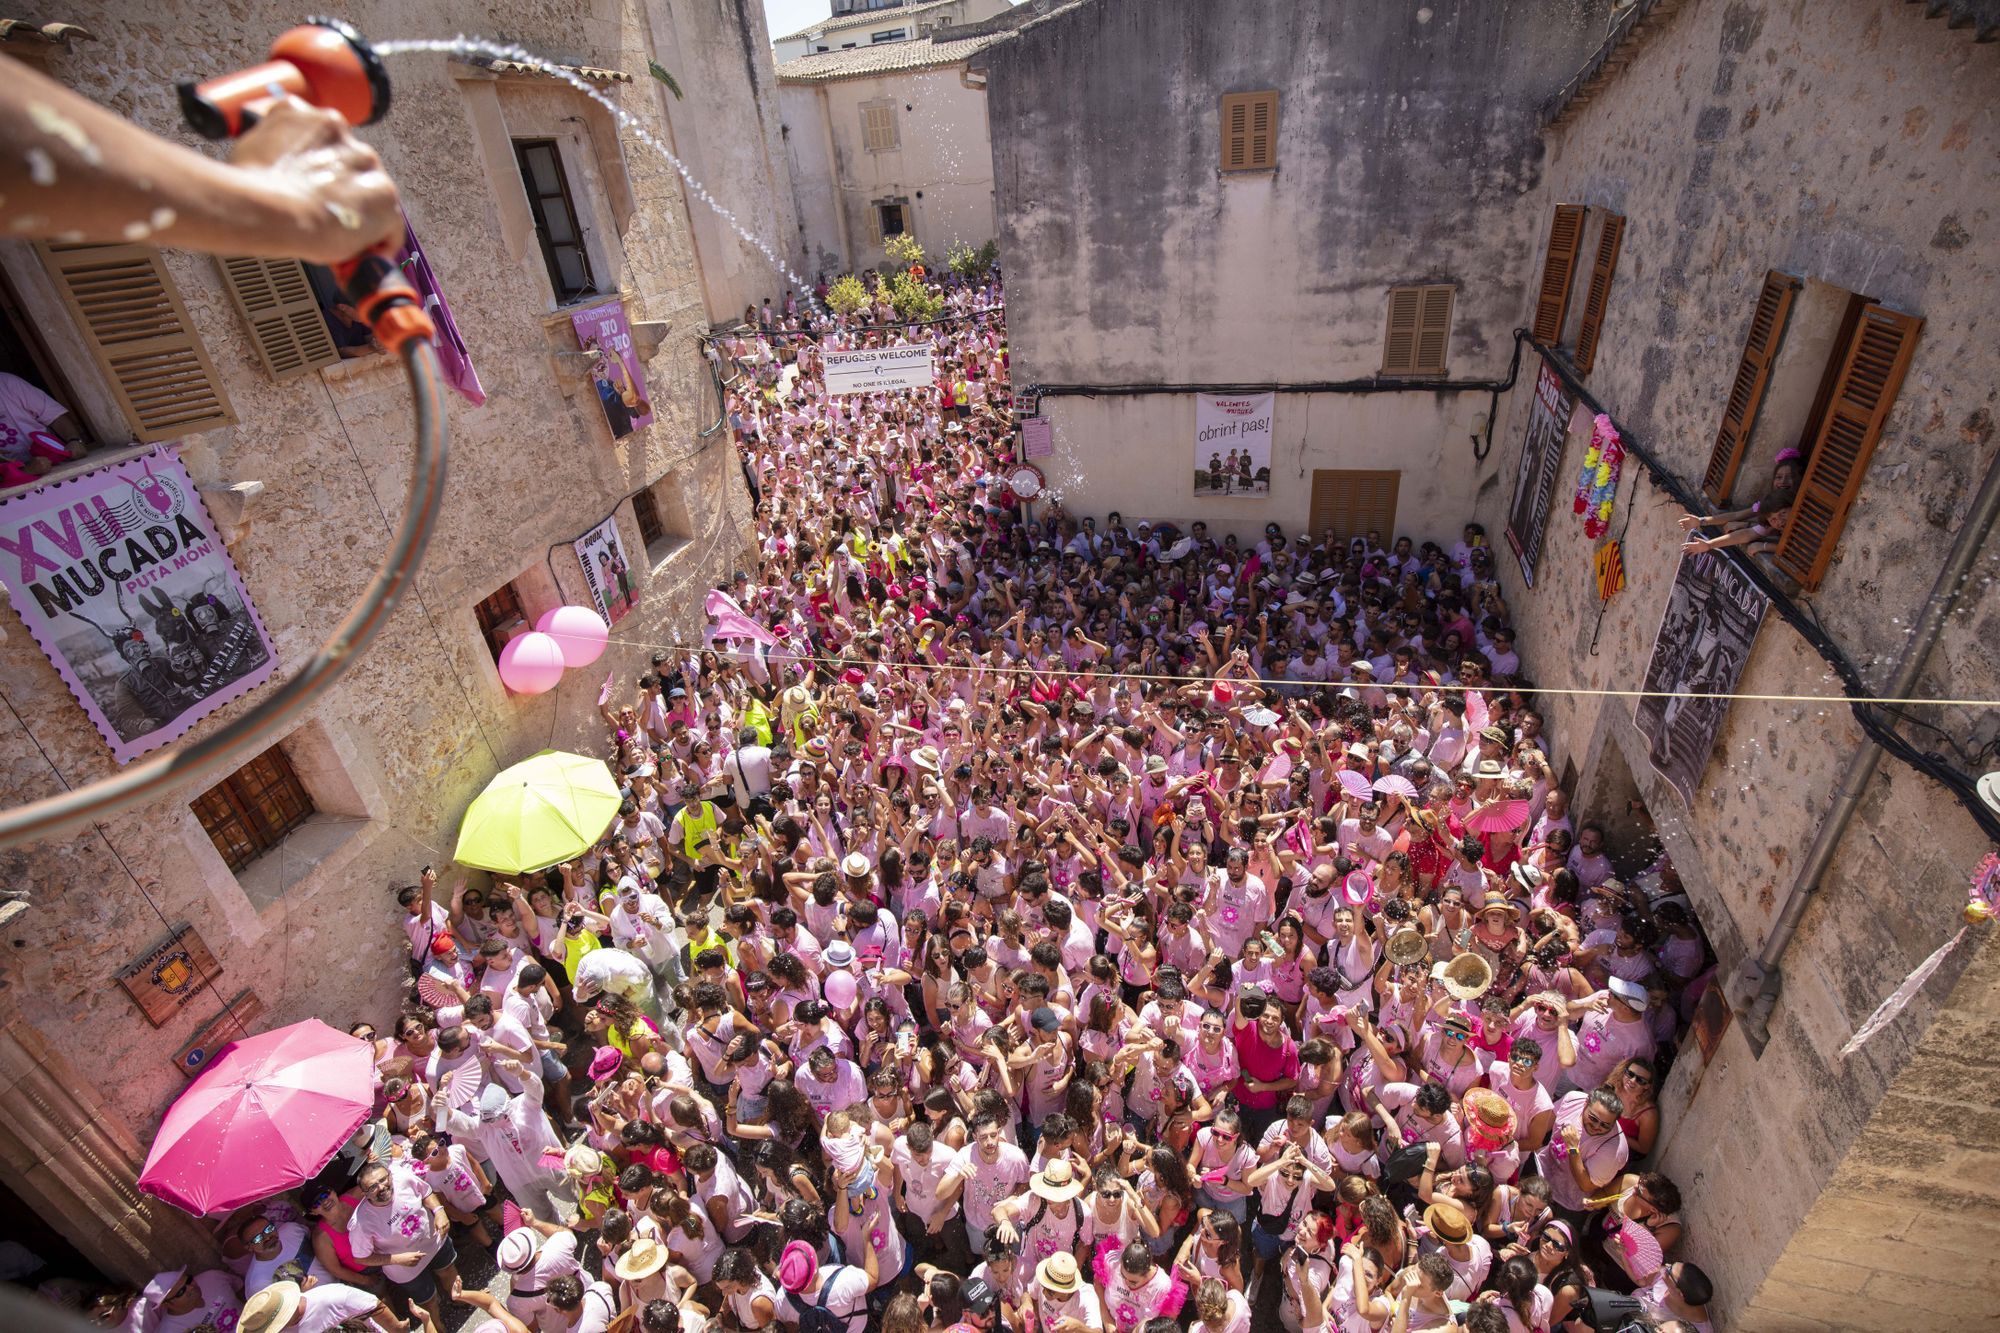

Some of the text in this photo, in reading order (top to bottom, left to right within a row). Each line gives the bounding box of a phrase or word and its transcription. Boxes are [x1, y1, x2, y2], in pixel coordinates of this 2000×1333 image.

[599, 318, 618, 336] NO
[612, 332, 631, 352] NO
[826, 348, 927, 365] REFUGEES WELCOME
[883, 378, 907, 386] ILLEGAL
[1199, 417, 1270, 442] obrint pas!
[0, 493, 126, 584] XVII
[29, 513, 207, 619] MUCADA
[126, 541, 215, 596] PUTA MÓN!
[1714, 561, 1760, 622] MUCADA
[193, 621, 245, 699] CANCELLED
[129, 930, 187, 978] AJUNTAMENT
[177, 983, 203, 1007] SINEU
